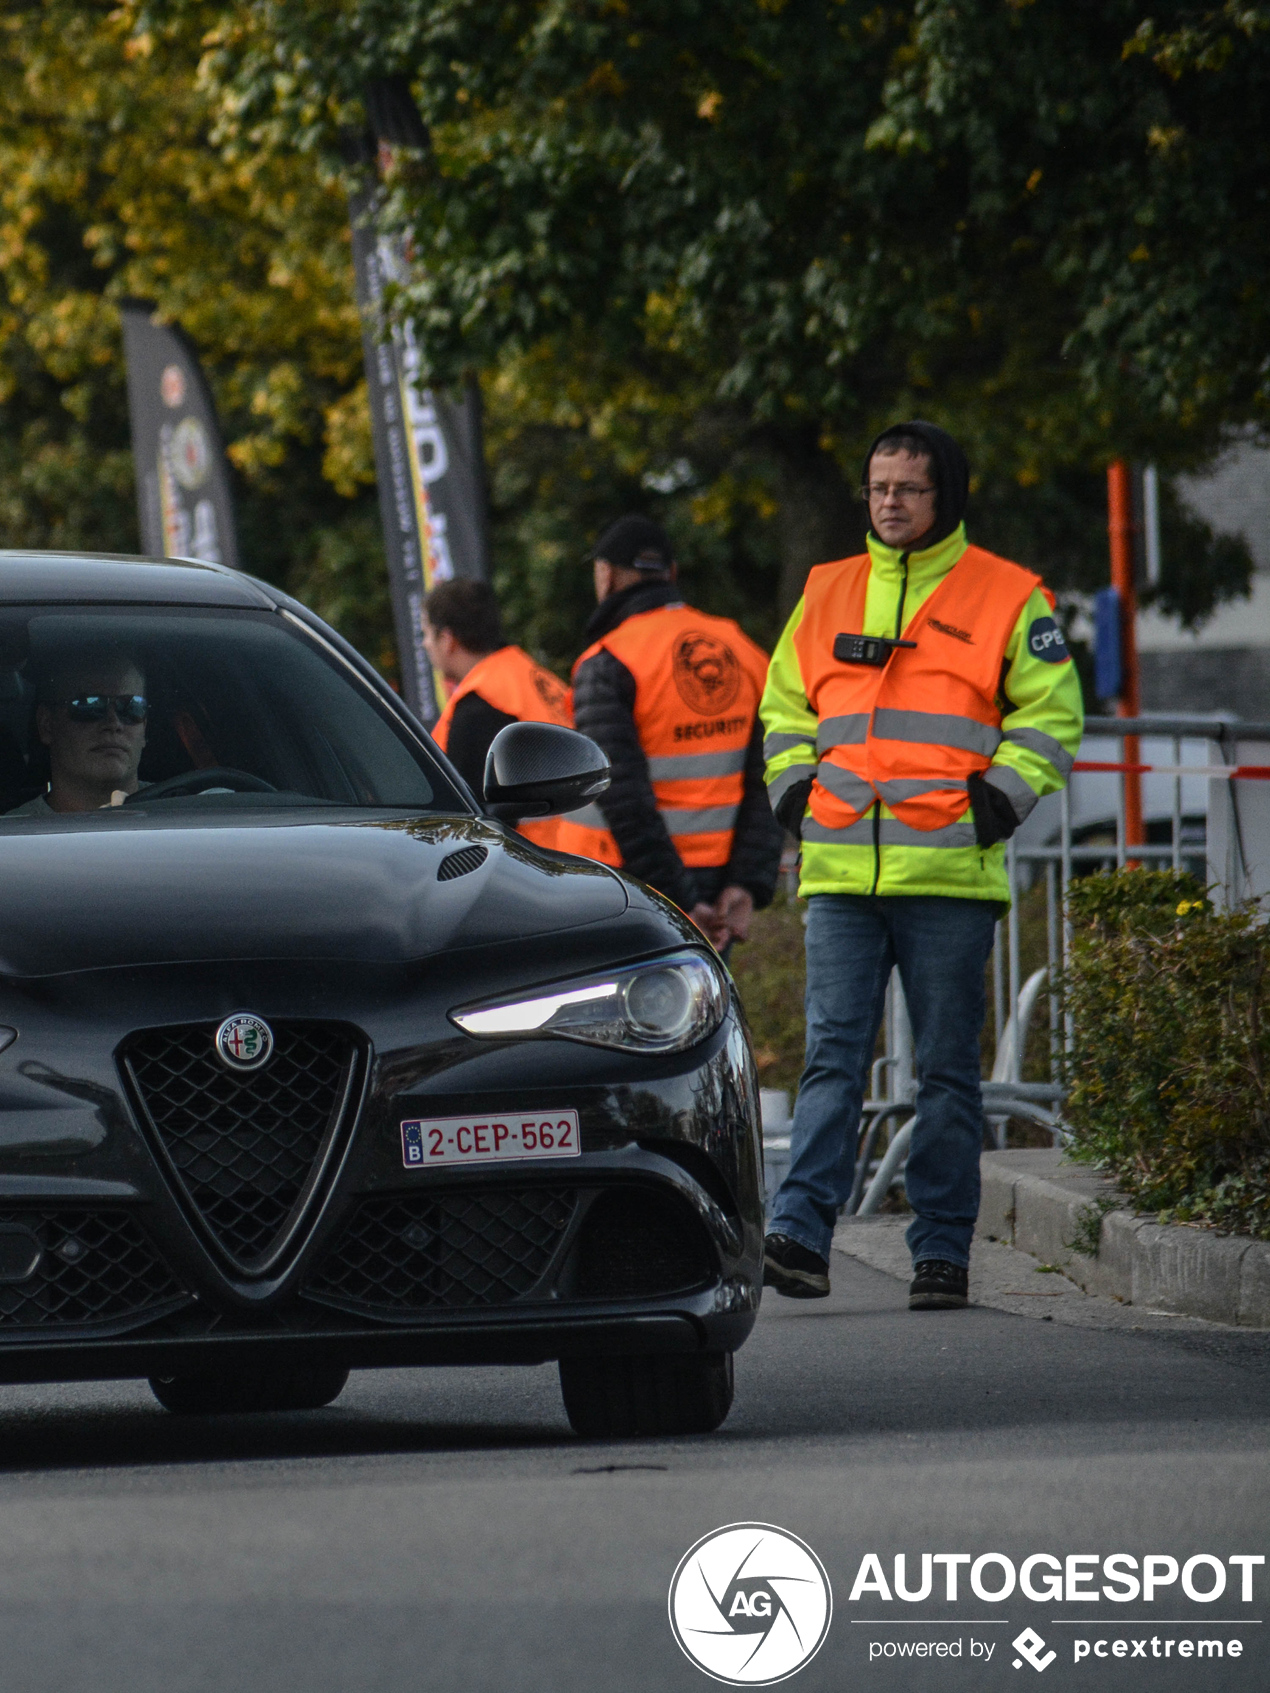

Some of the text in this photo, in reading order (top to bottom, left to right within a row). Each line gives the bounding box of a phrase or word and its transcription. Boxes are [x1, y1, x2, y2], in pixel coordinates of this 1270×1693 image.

[673, 716, 747, 743] SECURITY
[223, 1019, 268, 1043] ALFA ROMEO
[428, 1120, 573, 1156] 2-CEP-562
[409, 1146, 421, 1161] B
